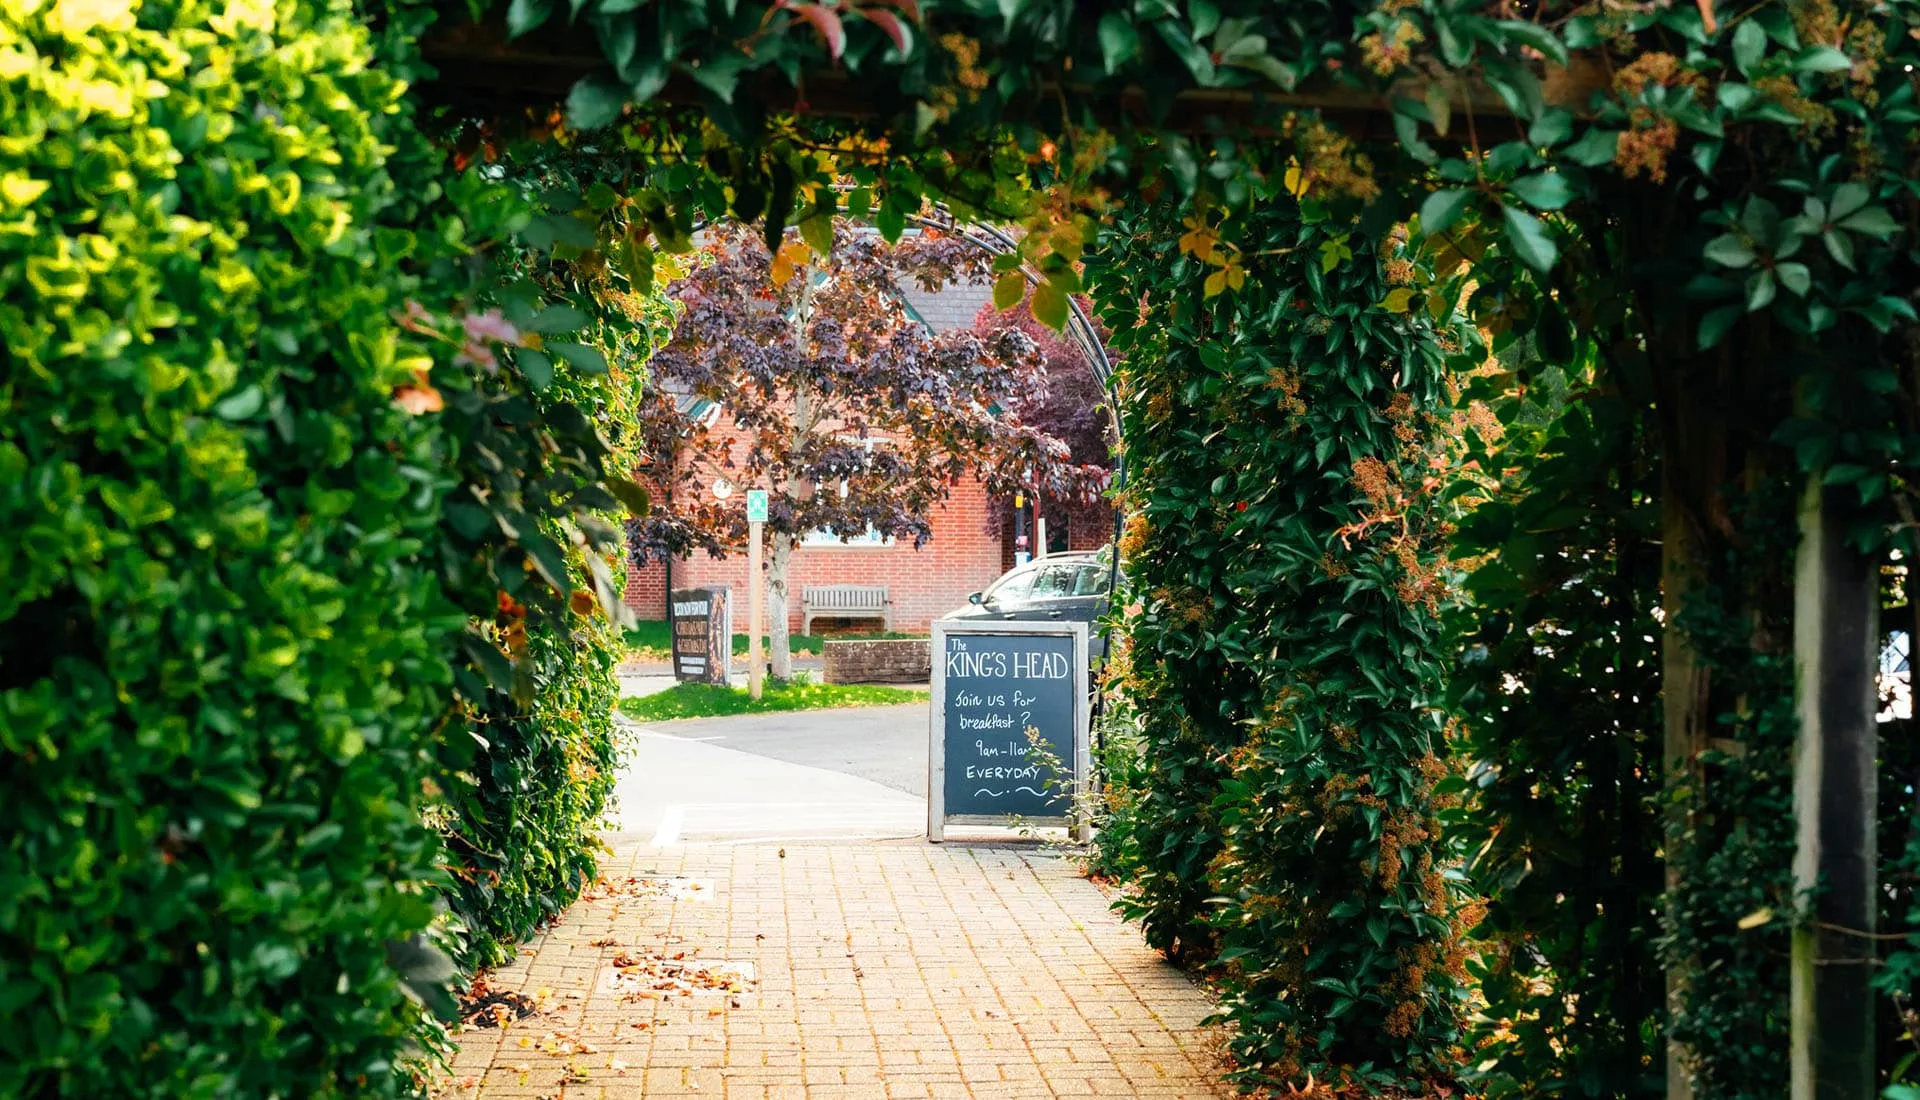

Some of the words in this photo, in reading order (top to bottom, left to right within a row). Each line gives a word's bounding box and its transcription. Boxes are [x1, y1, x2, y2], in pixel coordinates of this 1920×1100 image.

[951, 638, 967, 651] The
[946, 651, 1007, 678] KING'S
[1013, 652, 1069, 679] HEAD
[954, 689, 983, 707] Join
[987, 695, 1006, 707] us
[1012, 690, 1037, 707] for
[959, 713, 1015, 730] breakfast
[966, 765, 1041, 781] EVERYDAY
